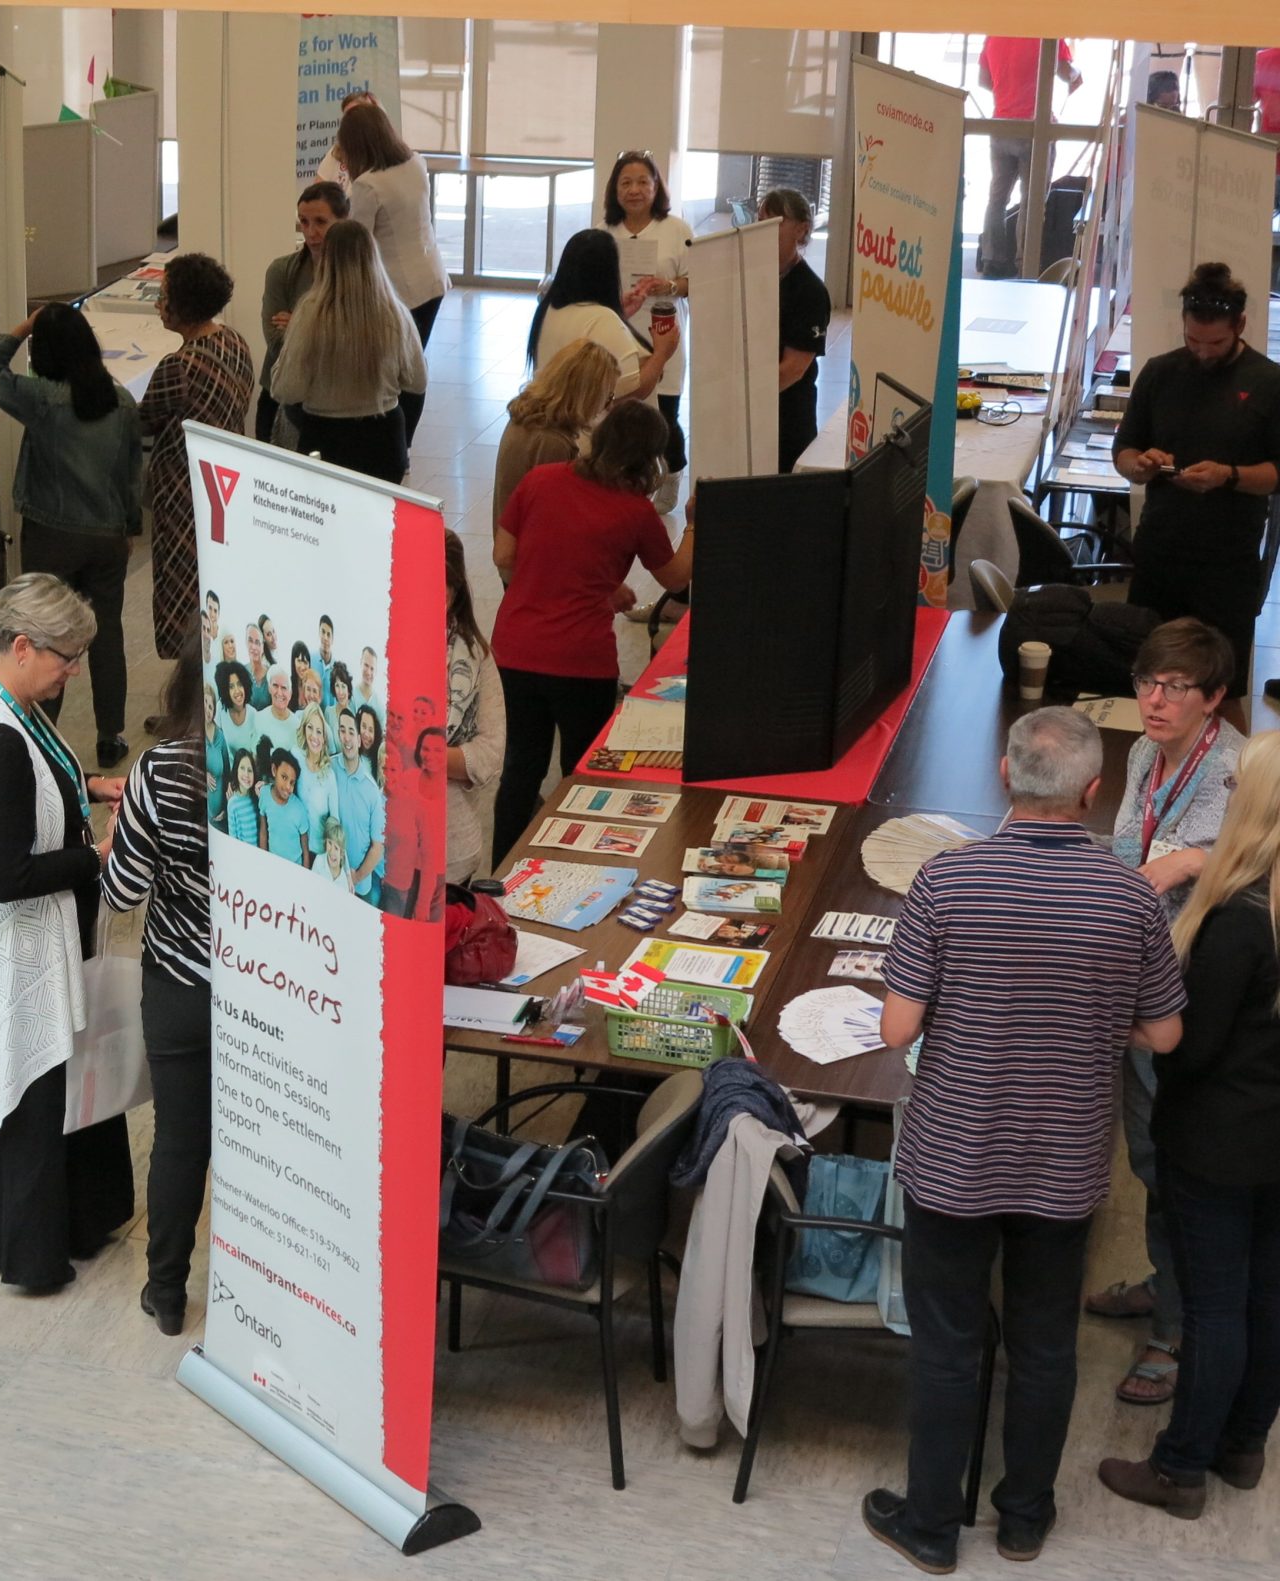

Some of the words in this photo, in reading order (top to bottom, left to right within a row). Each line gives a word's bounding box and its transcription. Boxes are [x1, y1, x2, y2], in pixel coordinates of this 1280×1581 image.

[312, 36, 334, 51] for
[338, 32, 378, 49] Work
[298, 56, 358, 77] raining?
[298, 90, 319, 104] an
[876, 103, 934, 133] csviamonde.ca
[310, 136, 328, 148] and
[857, 213, 897, 268] tout
[899, 236, 923, 278] est
[859, 267, 935, 332] possible
[253, 477, 278, 495] YMCAs
[280, 487, 288, 497] of
[289, 490, 329, 513] Cambridge
[330, 503, 336, 514] &
[253, 494, 324, 525] Kitchener-Waterloo
[253, 516, 289, 538] Immigrant
[290, 527, 320, 546] Services
[224, 998, 238, 1019] Us
[241, 1009, 284, 1042] About:
[216, 1023, 249, 1054] Group
[252, 1043, 304, 1082] Activities
[306, 1073, 328, 1096] and
[216, 1046, 281, 1093] Information
[284, 1083, 331, 1122] Sessions
[216, 1076, 238, 1100] One
[240, 1091, 252, 1108] to
[255, 1097, 279, 1122] One
[282, 1111, 342, 1160] Settlement
[217, 1099, 261, 1136] Support
[217, 1128, 281, 1178] Community
[284, 1165, 351, 1220] Connections
[211, 1168, 280, 1220] itchener-Waterloo
[281, 1212, 308, 1237] Office:
[309, 1228, 360, 1273] 519-579-9622
[250, 1215, 276, 1240] Office:
[277, 1231, 331, 1272] 519-621-1621
[212, 1232, 357, 1337] ymcaimmigrantservices.ca
[234, 1303, 282, 1348] Ontario
